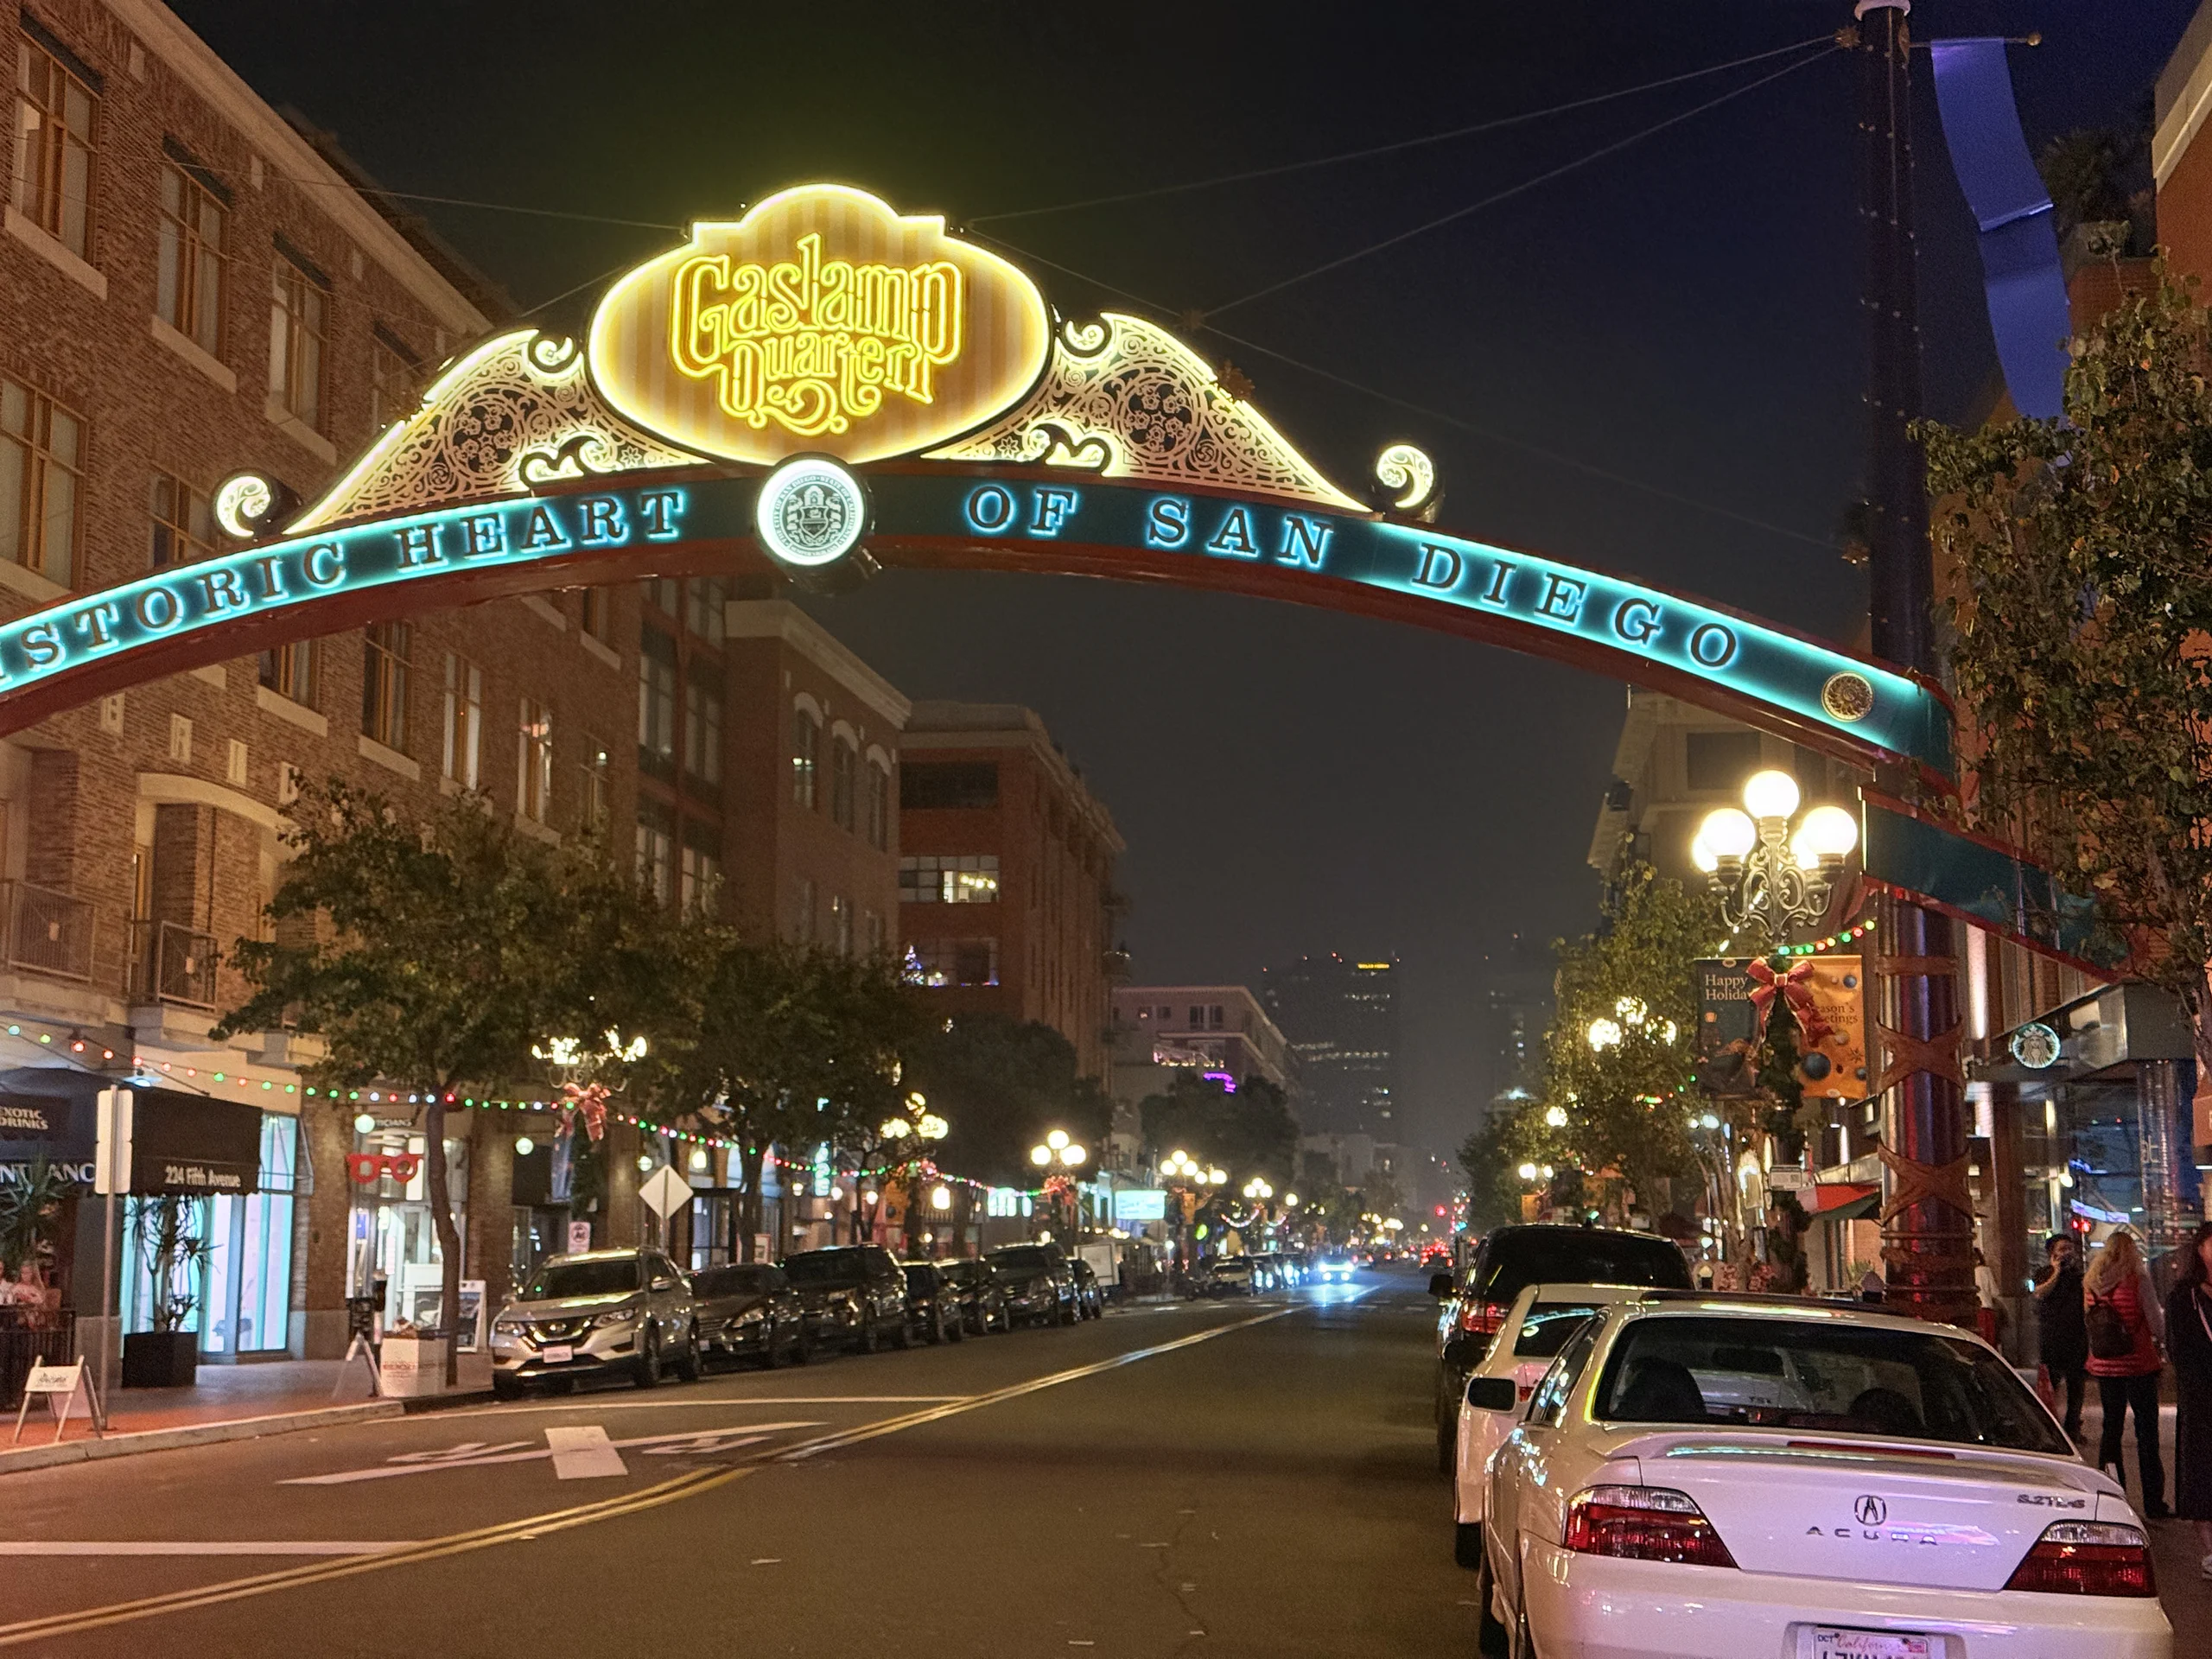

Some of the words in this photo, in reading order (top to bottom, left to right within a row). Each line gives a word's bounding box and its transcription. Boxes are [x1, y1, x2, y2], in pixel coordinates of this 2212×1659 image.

[671, 232, 963, 404] Gaslamp
[718, 332, 929, 436] Quarter
[395, 490, 684, 572] HEART
[967, 485, 1077, 536] OF
[1148, 498, 1334, 569] SAN
[1411, 543, 1739, 671] DIEGO
[1705, 974, 1748, 989] Happy
[0, 1117, 48, 1130] DRINKS
[164, 1165, 185, 1185] 224
[186, 1166, 207, 1186] Fifth
[208, 1169, 241, 1188] Avenue
[1806, 1525, 1939, 1546] ACURA
